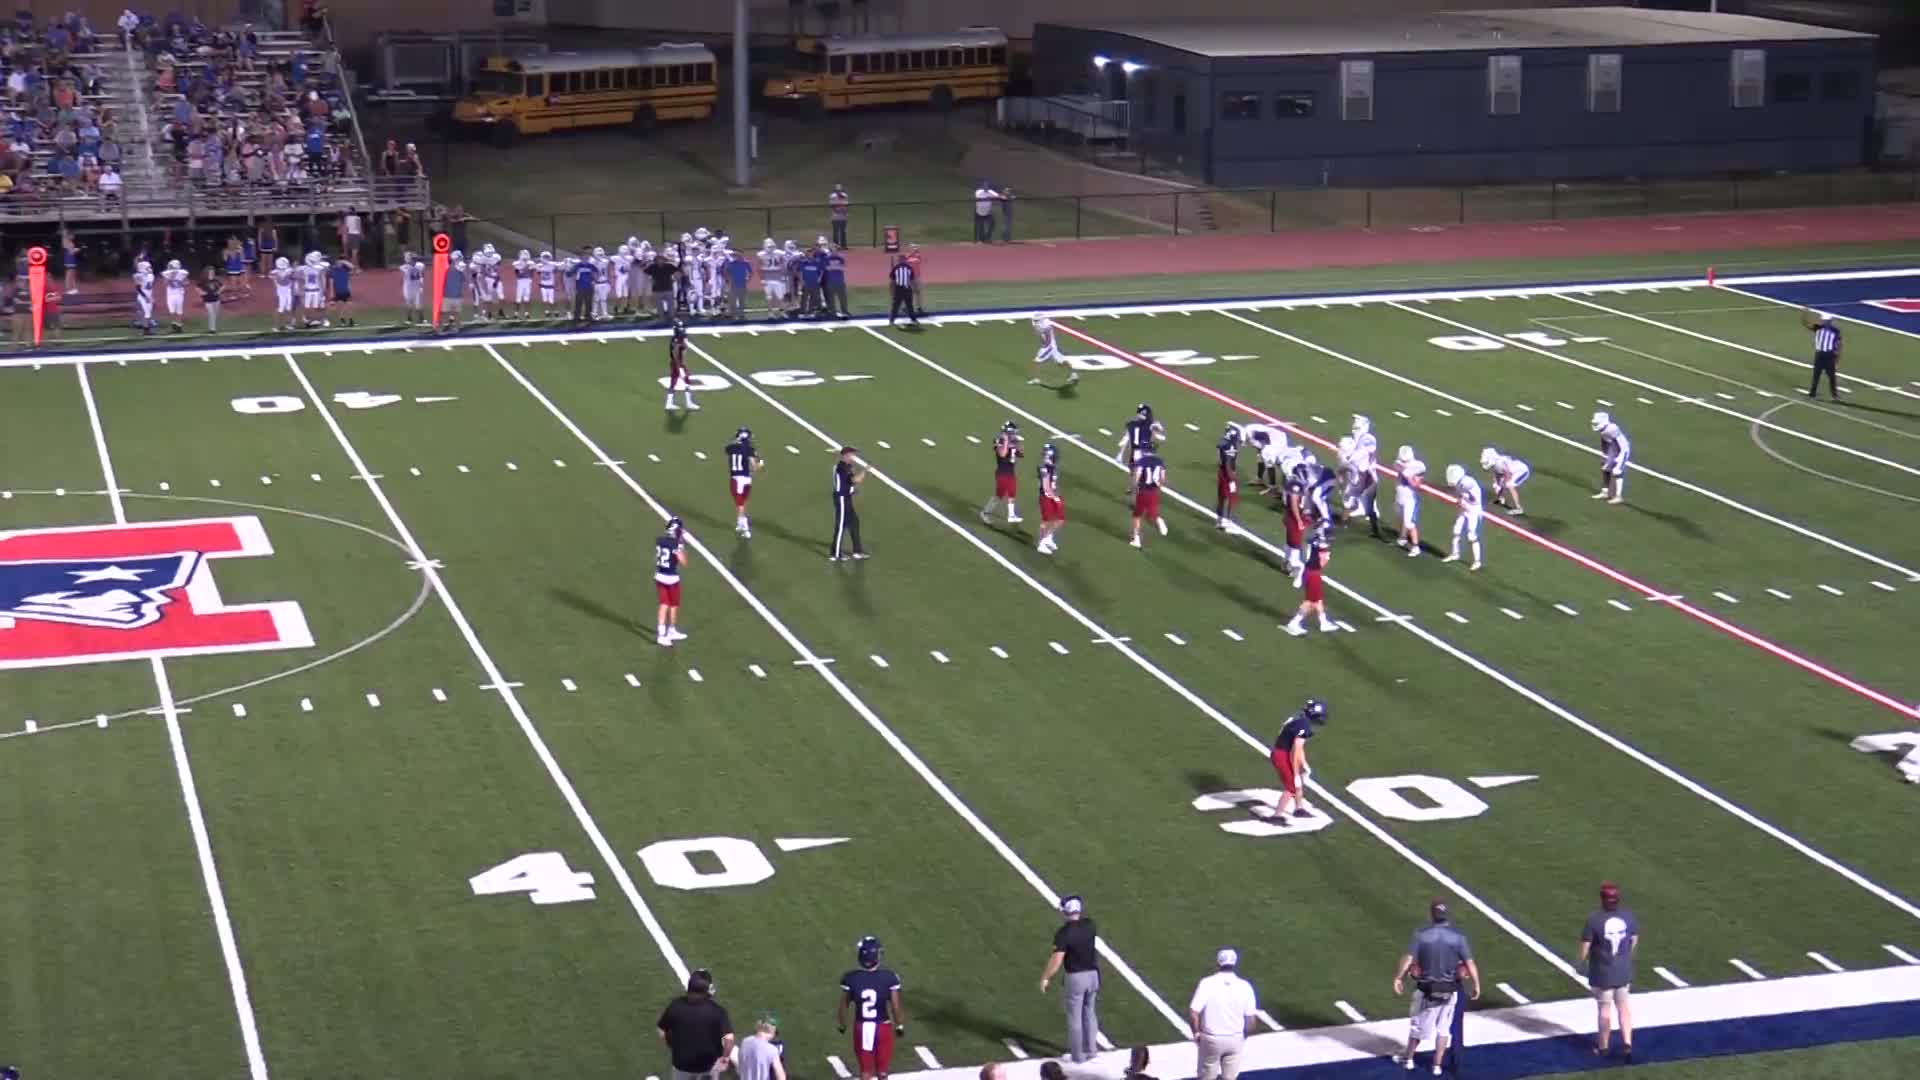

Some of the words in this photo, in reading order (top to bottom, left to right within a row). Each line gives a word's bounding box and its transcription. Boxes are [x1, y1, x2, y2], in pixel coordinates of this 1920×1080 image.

[1427, 332, 1568, 350] 10
[1061, 350, 1217, 370] 20
[657, 369, 825, 390] 30
[231, 392, 402, 413] 40
[731, 453, 744, 471] 11
[1191, 774, 1490, 836] 30
[469, 836, 776, 904] 40
[861, 988, 877, 1018] 2
